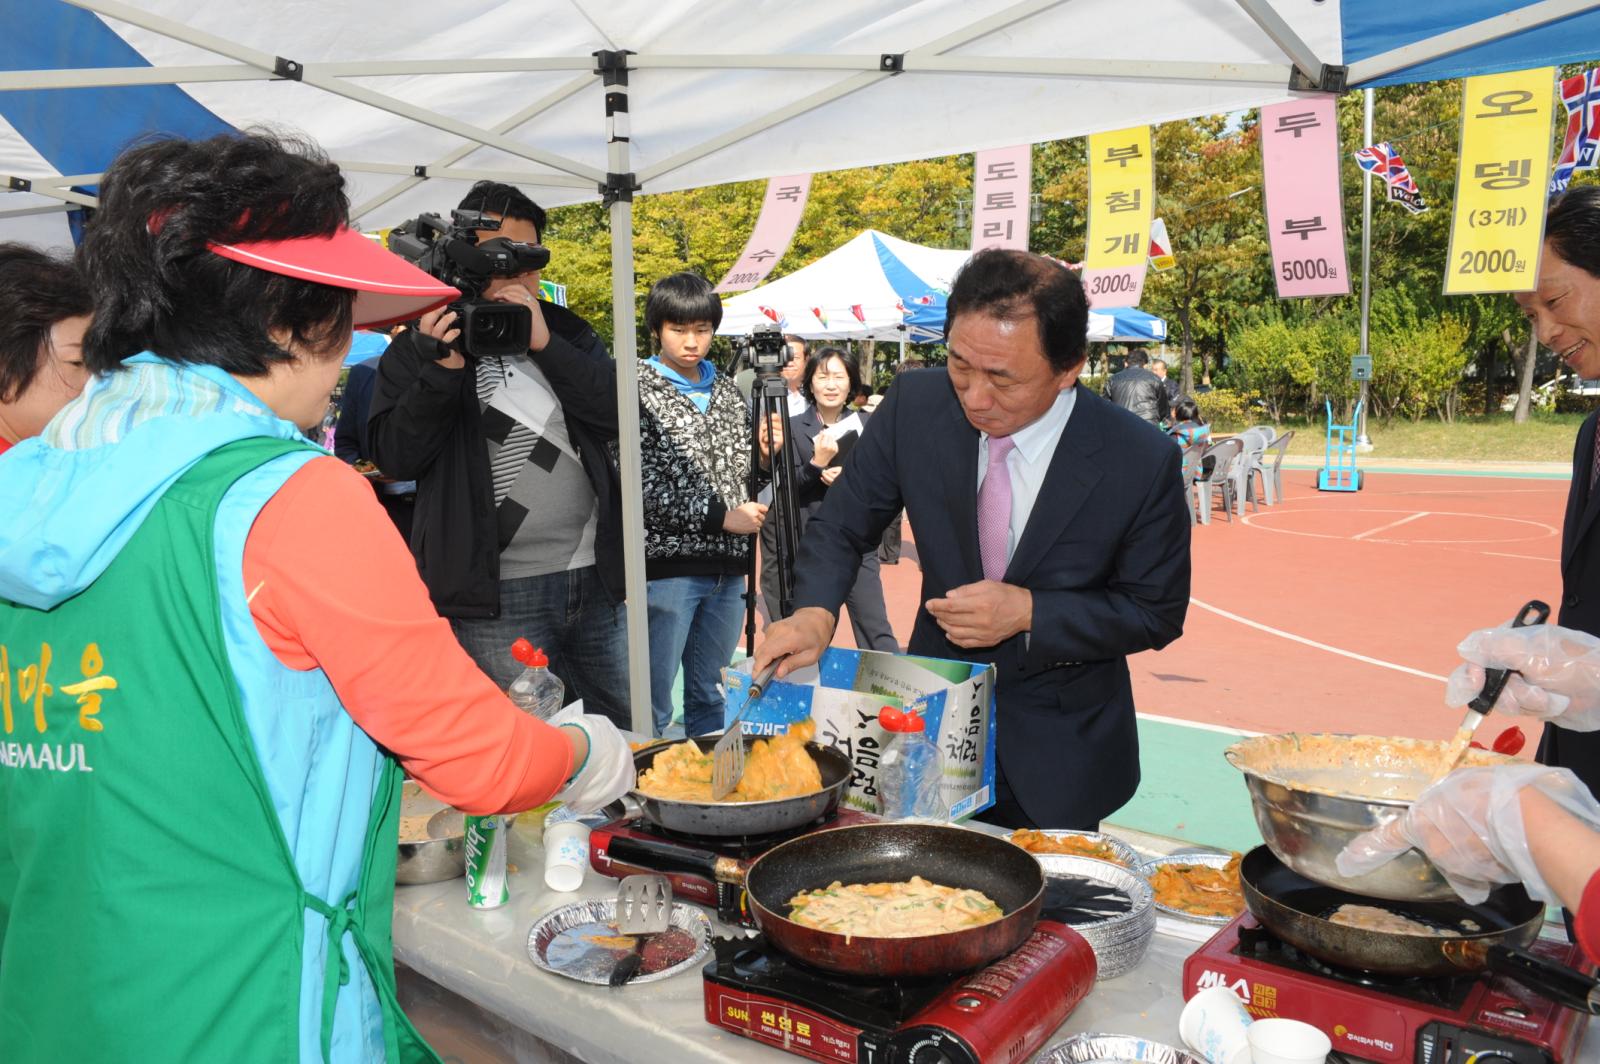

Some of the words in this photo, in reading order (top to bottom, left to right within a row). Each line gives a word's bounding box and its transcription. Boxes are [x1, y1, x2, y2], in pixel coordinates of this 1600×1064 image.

[1475, 90, 1537, 190] 오뎅
[1275, 111, 1327, 240] 두부
[983, 161, 1018, 240] 도토리
[1103, 143, 1142, 254] 부침개
[1468, 206, 1527, 227] (3개)
[1281, 257, 1338, 281] 5000원
[1458, 248, 1527, 275] 2000원
[1091, 273, 1137, 295] 3000원
[727, 1006, 750, 1022] SUN
[761, 1010, 812, 1037] 썬연료
